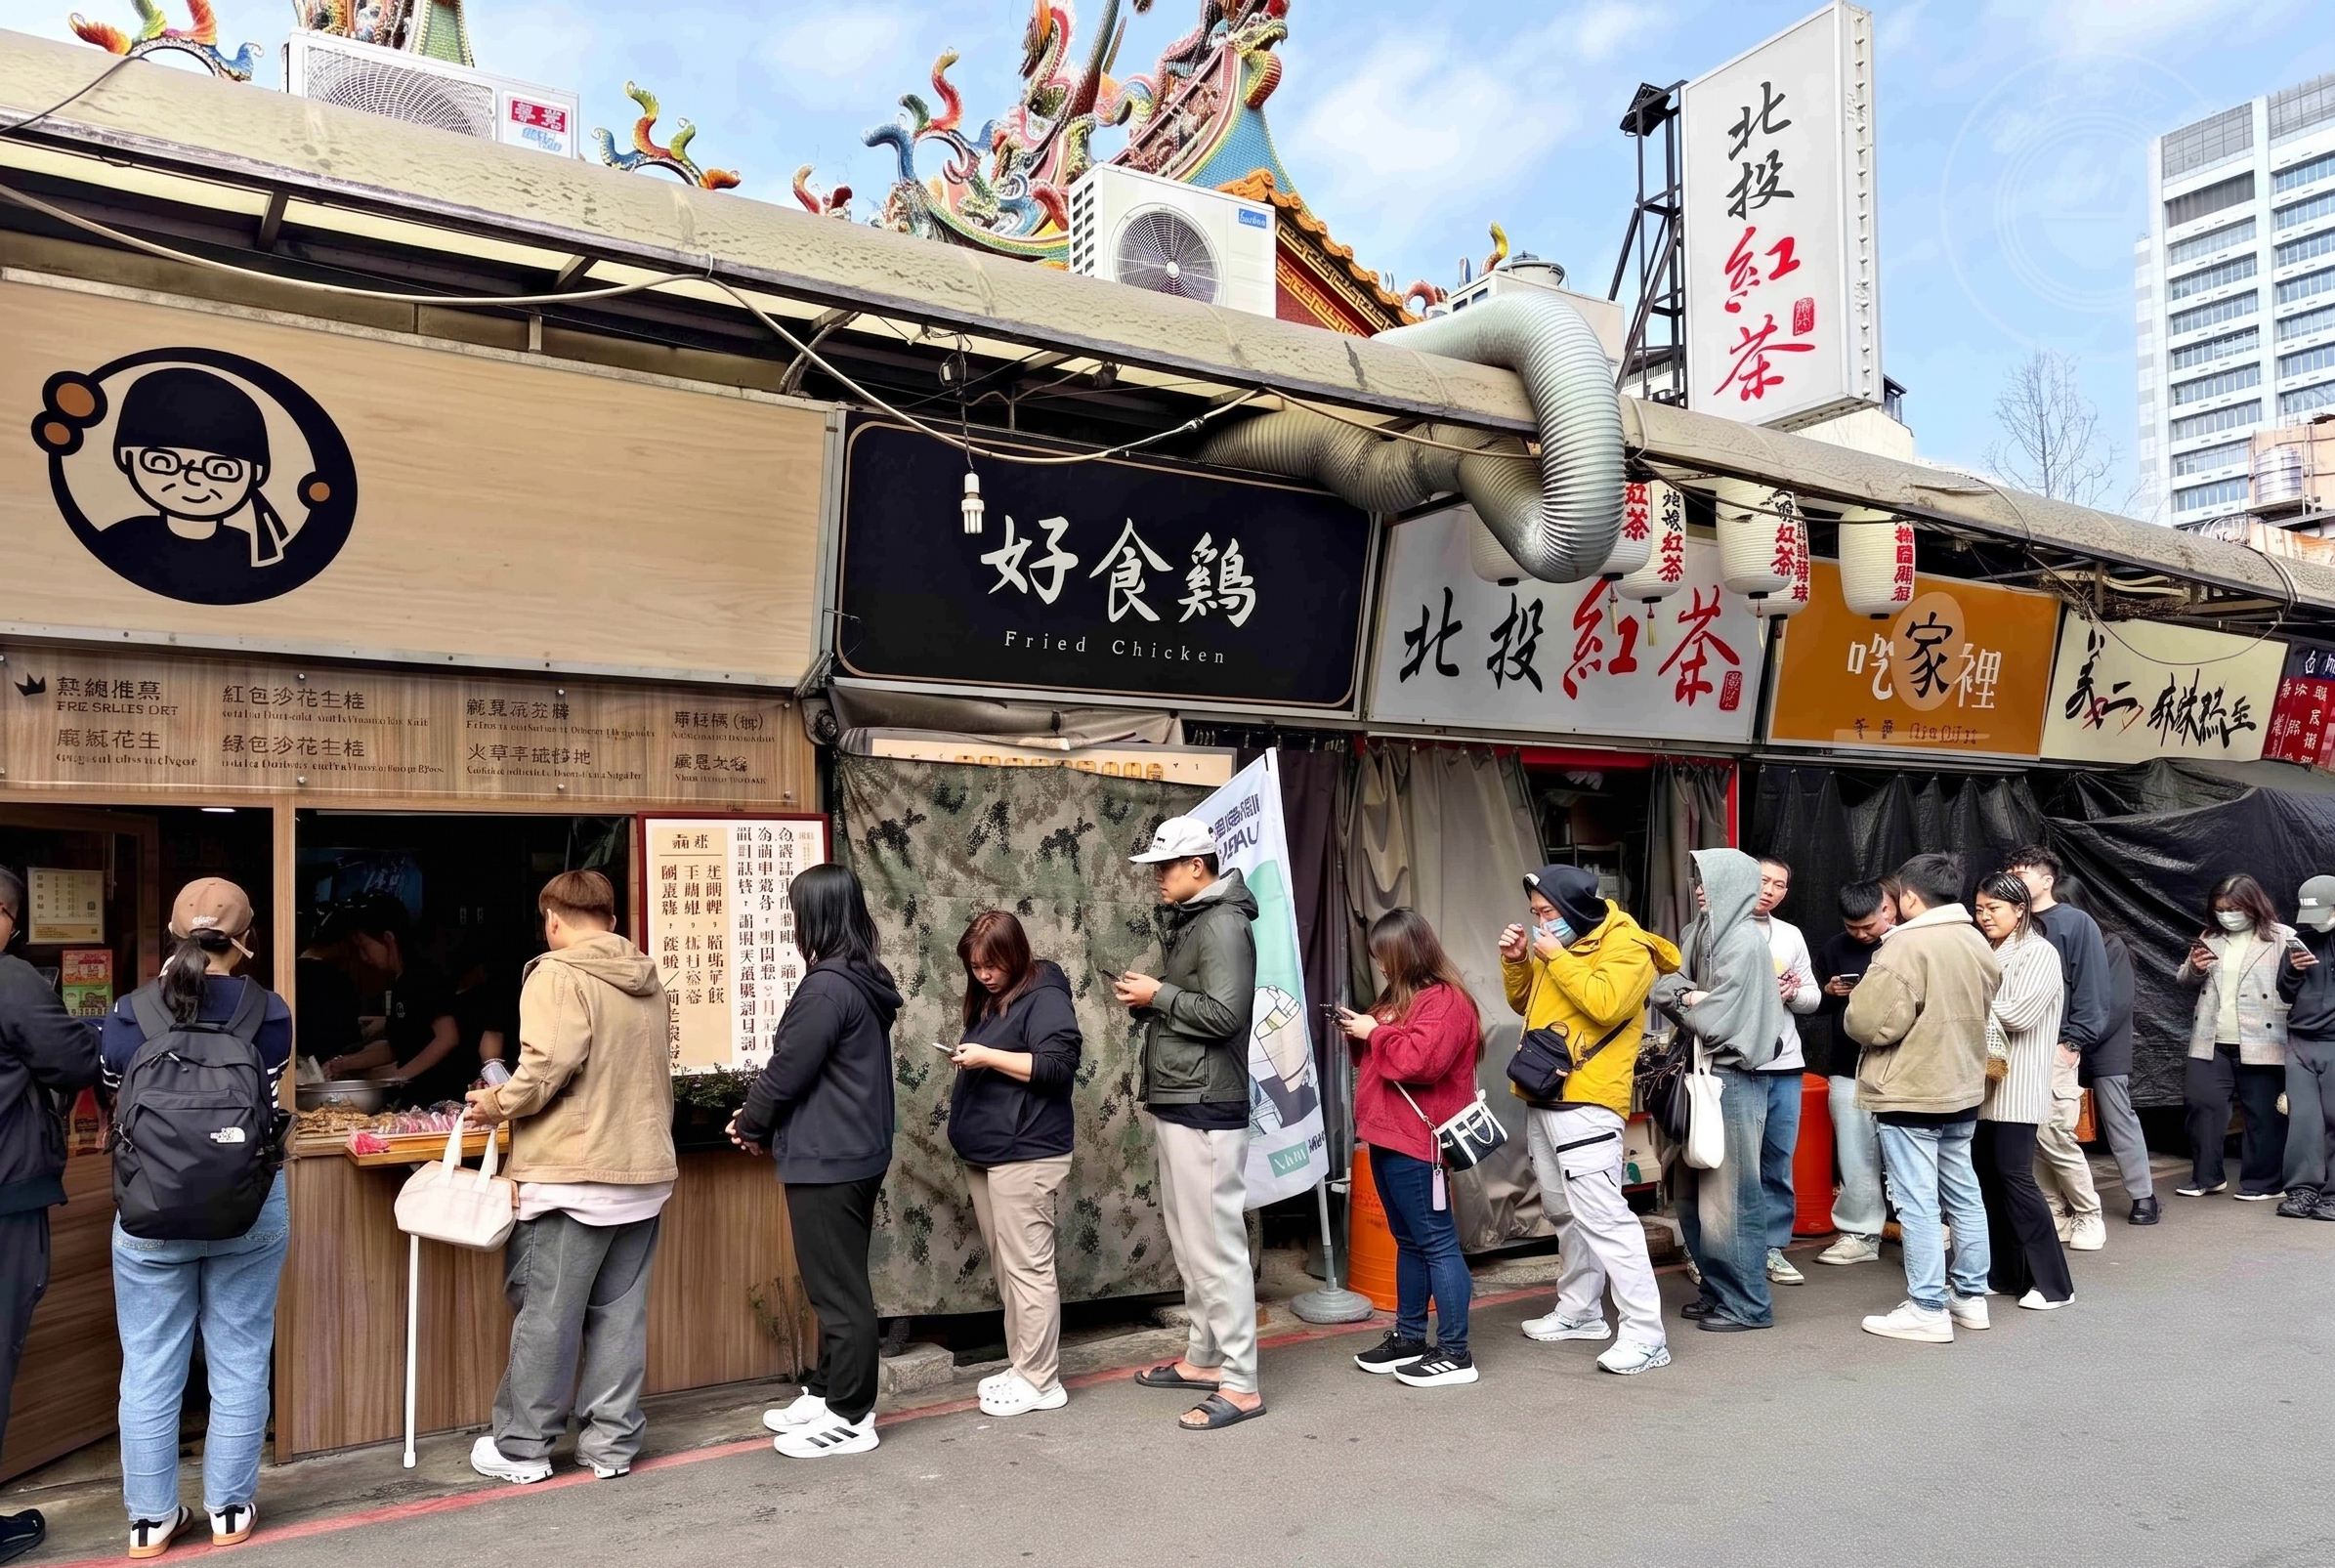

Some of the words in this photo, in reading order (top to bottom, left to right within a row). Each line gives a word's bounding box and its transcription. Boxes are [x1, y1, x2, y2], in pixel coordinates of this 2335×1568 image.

[1714, 81, 1816, 403] 北投紅茶
[1004, 630, 1086, 654] Fried
[1112, 639, 1225, 664] Chicken
[1399, 575, 1741, 707] 北投紅茶
